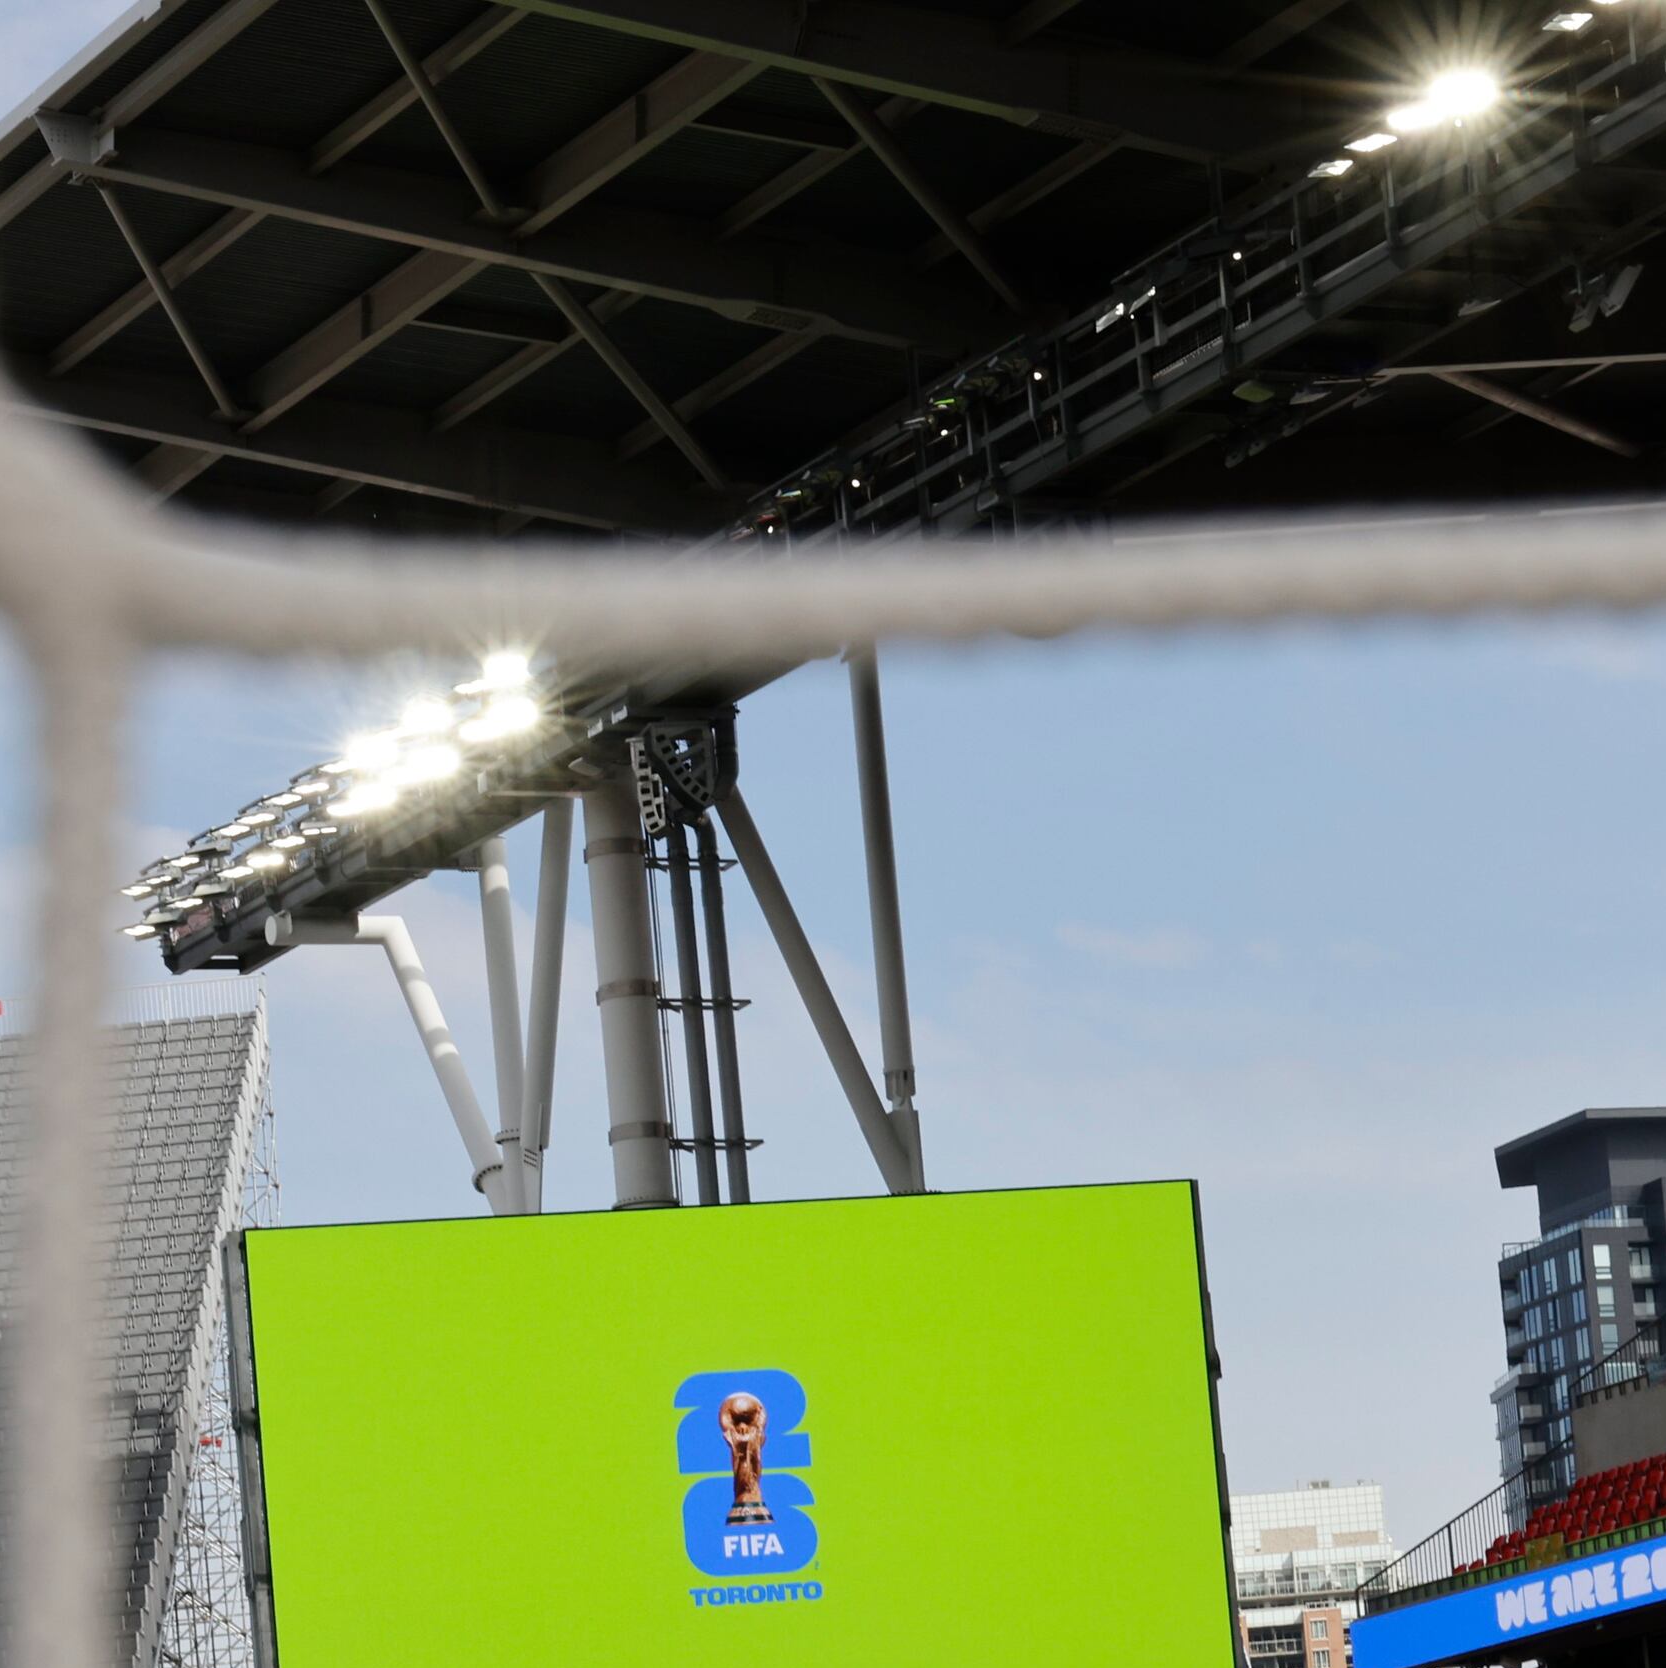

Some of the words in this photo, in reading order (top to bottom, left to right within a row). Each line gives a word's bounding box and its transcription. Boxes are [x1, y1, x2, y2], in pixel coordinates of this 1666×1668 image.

[723, 1533, 785, 1558] FIFA
[690, 1581, 823, 1607] TORONTO
[1495, 1580, 1548, 1632] WE
[1550, 1561, 1619, 1617] ARE
